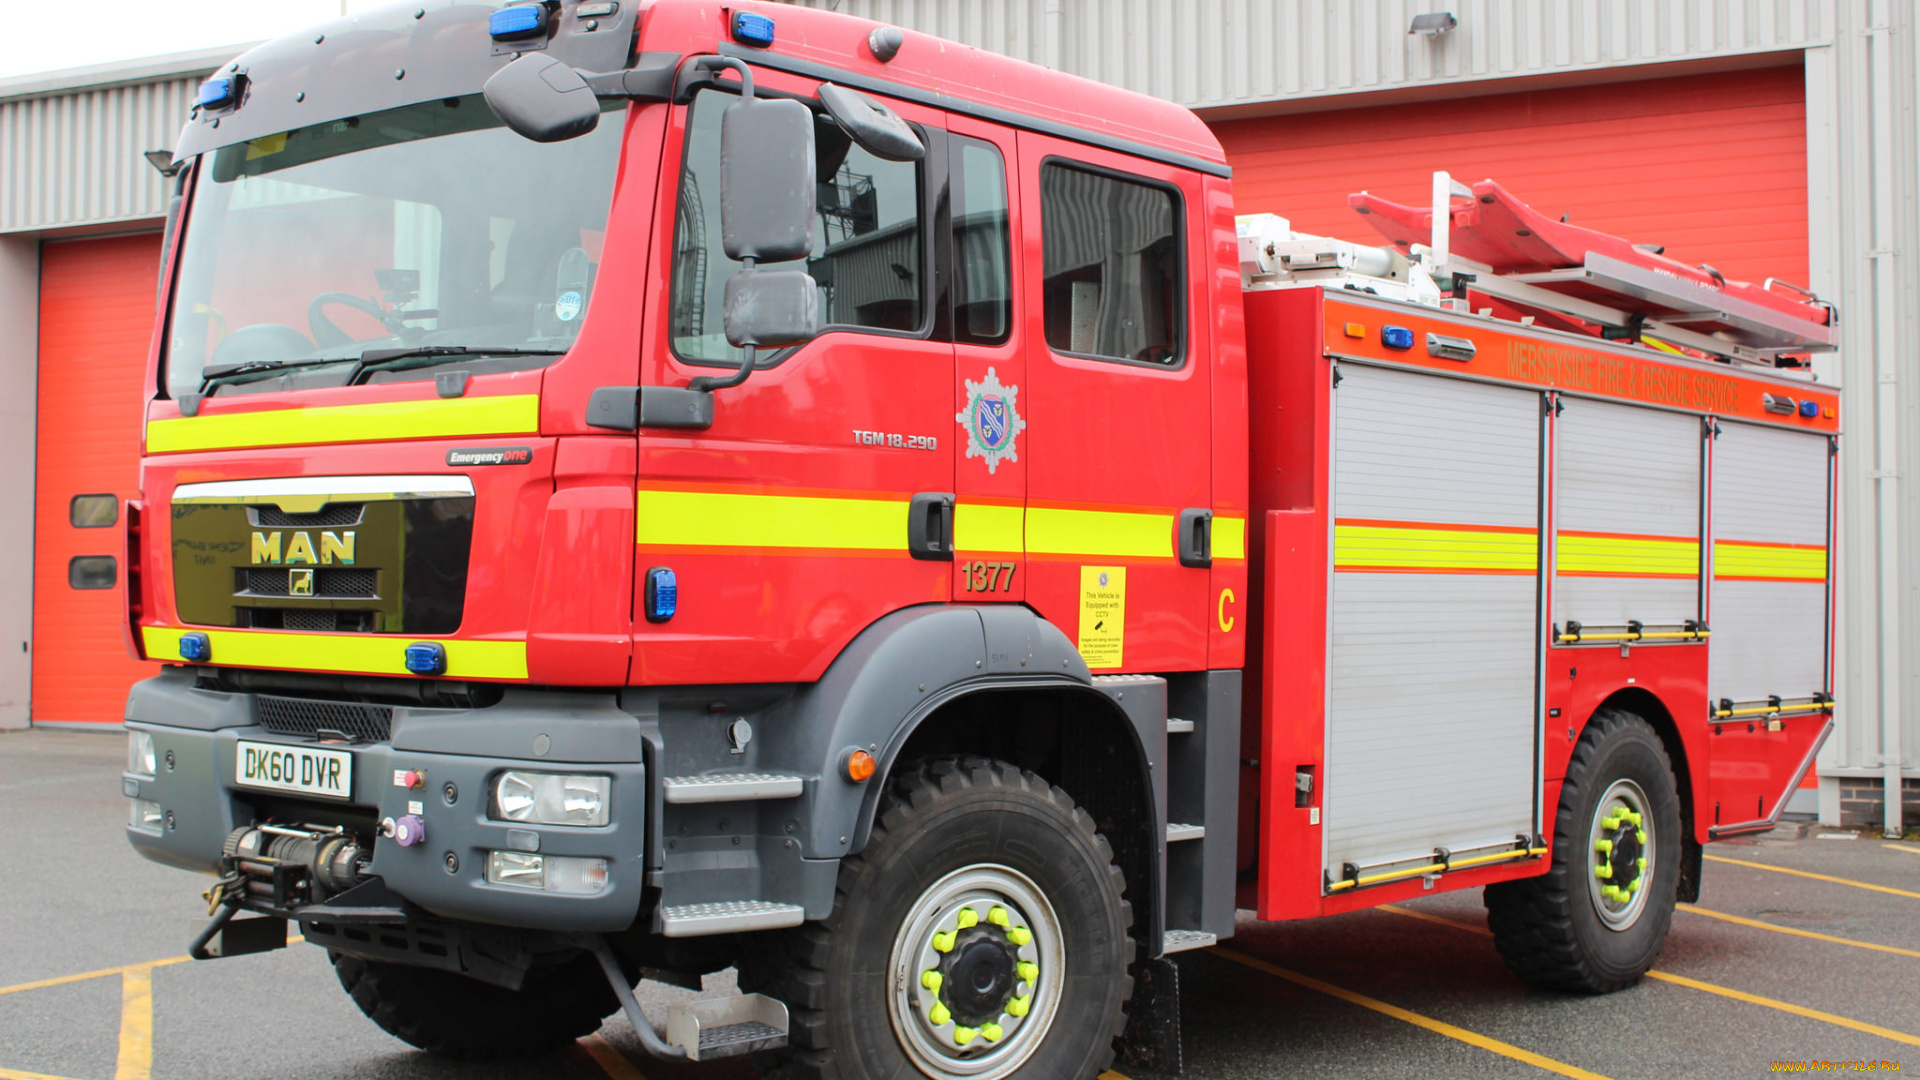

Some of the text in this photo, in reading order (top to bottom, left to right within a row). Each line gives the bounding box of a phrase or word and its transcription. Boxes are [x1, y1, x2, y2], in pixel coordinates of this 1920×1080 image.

[1508, 341, 1738, 412] MERSEYSIDE FIRE & RESCUE SERVICE
[852, 430, 937, 450] TGM 18.290
[251, 531, 356, 565] MAN
[962, 561, 1016, 592] 1377
[1085, 601, 1108, 610] Equipped
[1218, 588, 1235, 633] C
[246, 748, 341, 790] DK60 DVR
